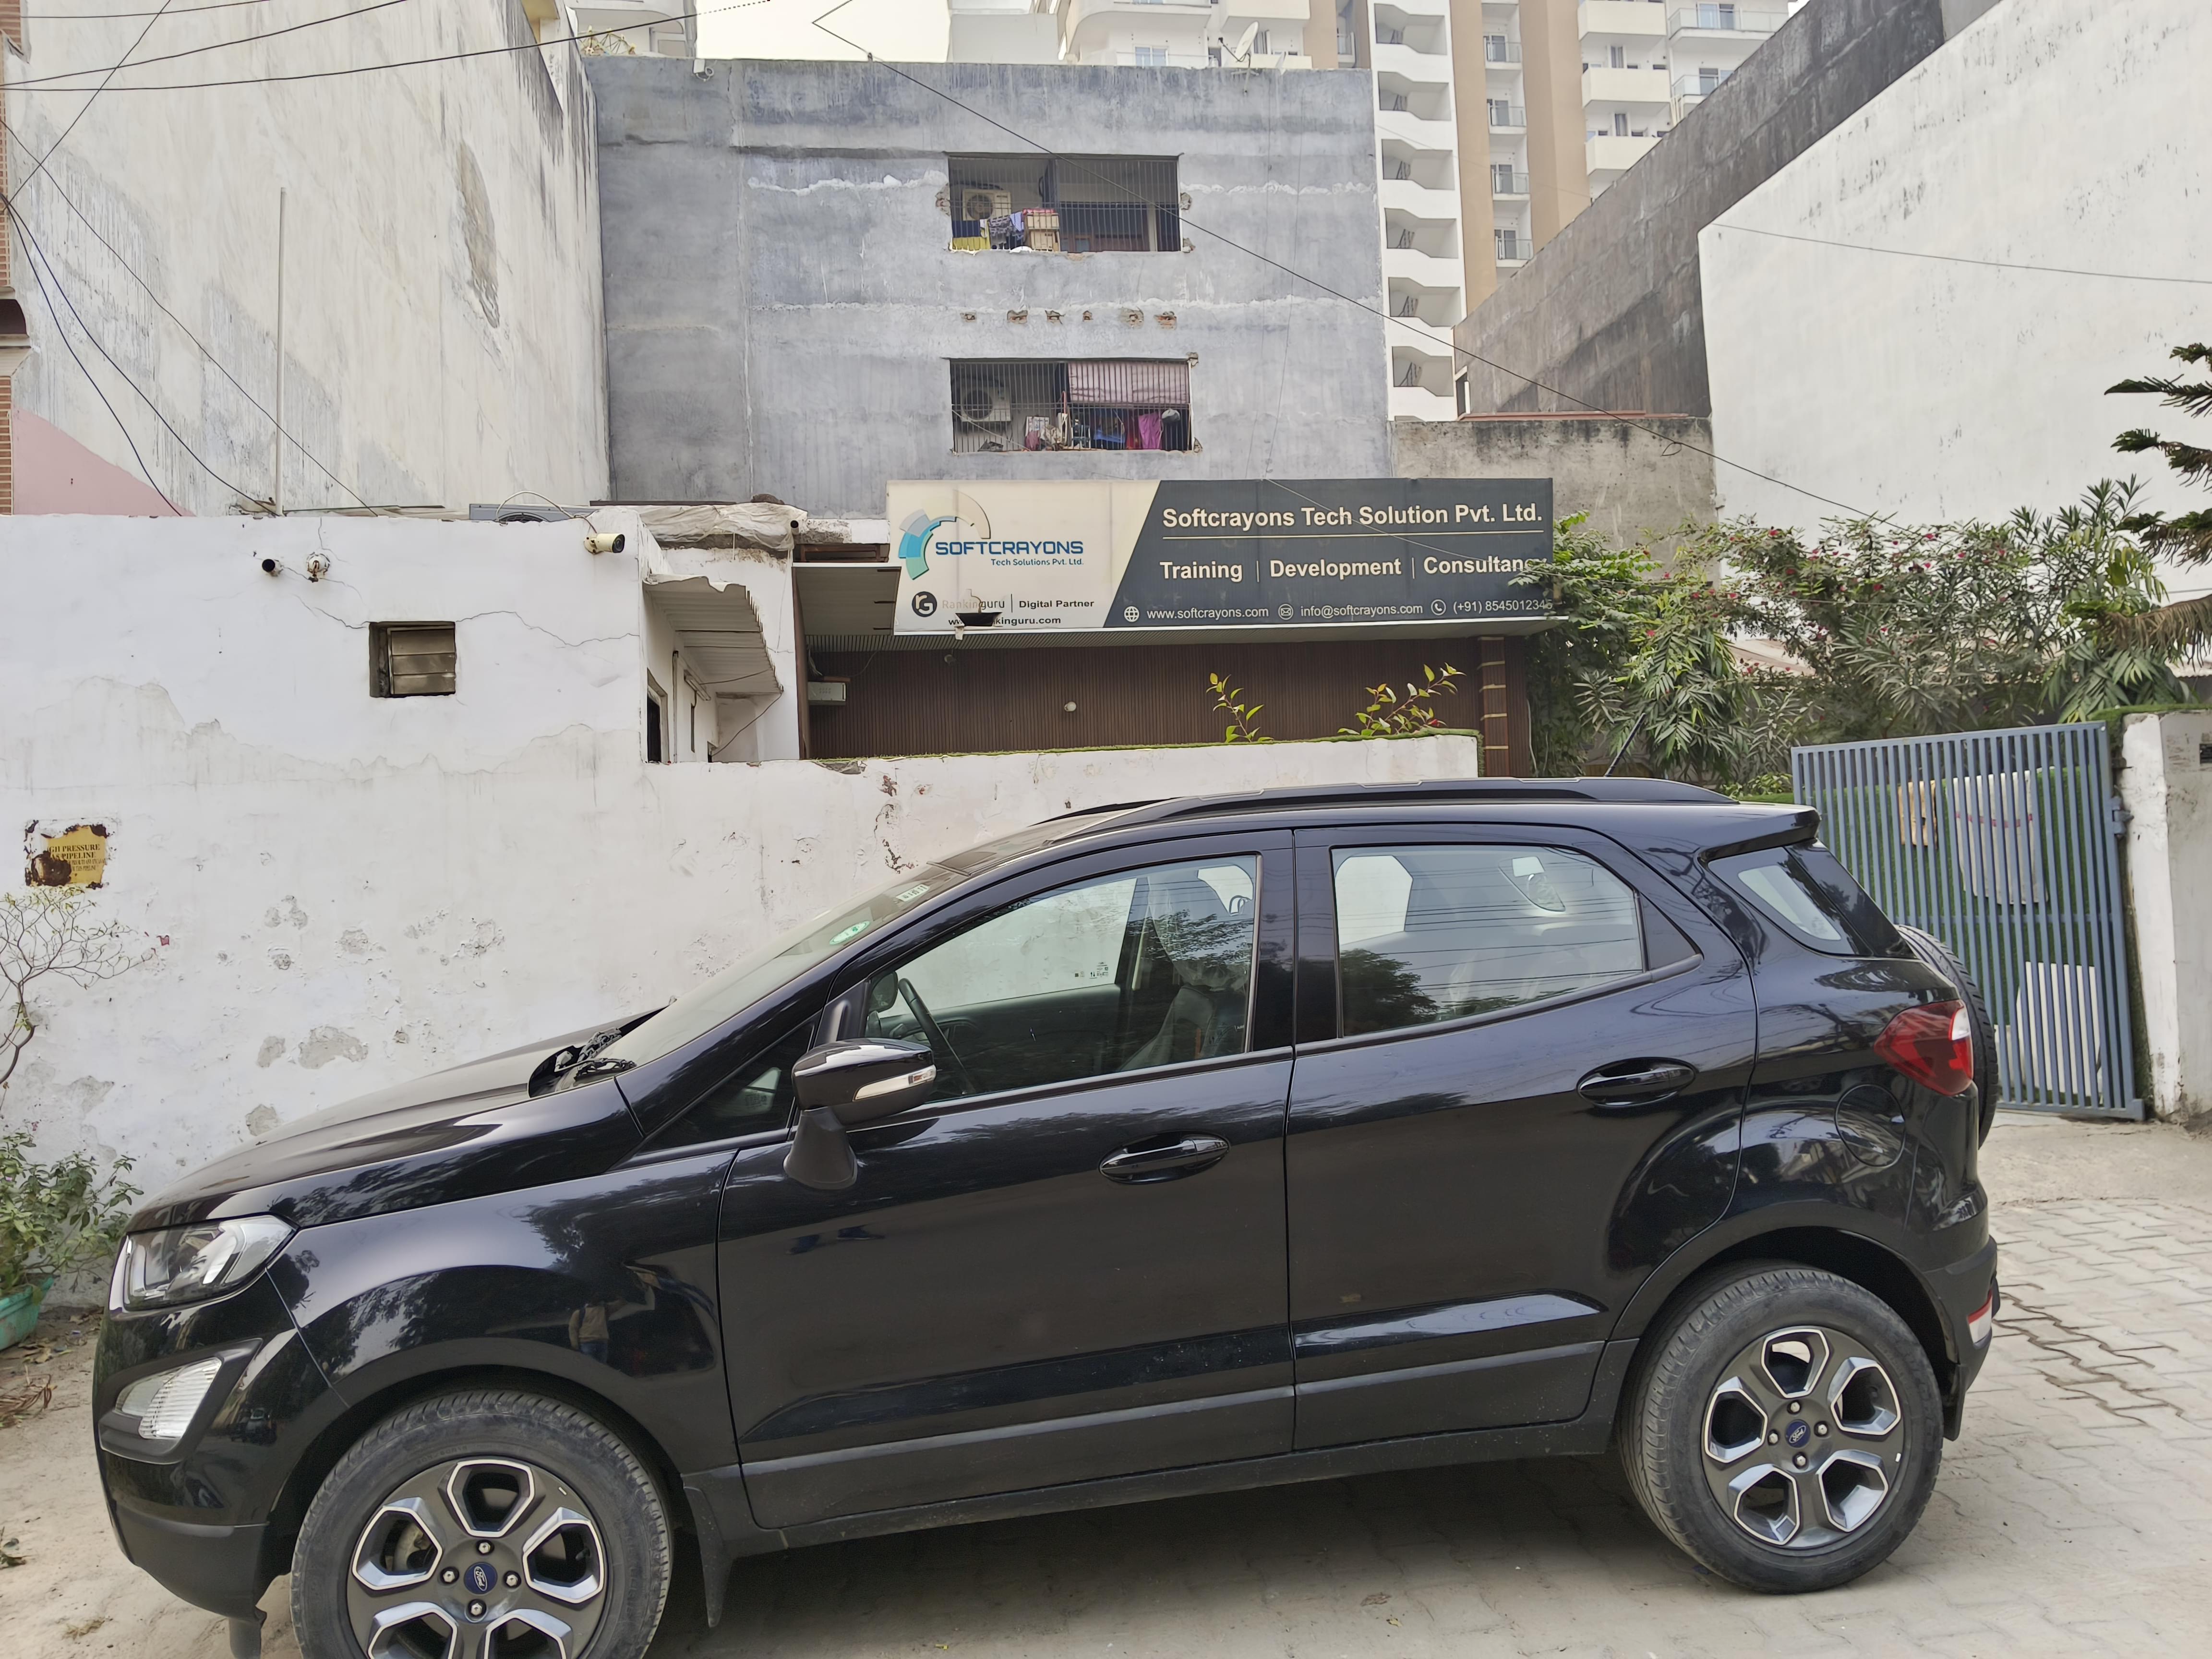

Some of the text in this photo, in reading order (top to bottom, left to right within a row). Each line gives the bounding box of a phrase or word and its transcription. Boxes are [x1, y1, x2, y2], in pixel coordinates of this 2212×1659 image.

[1163, 503, 1542, 531] Softcrayons Tech Solution Pvt. Ltd.
[936, 541, 1083, 555] SOFTCRAYONS
[1159, 555, 1547, 583] Training Development Consultanc
[1019, 600, 1052, 610] Digital
[1056, 600, 1094, 608] Partner
[1146, 608, 1269, 620] www.softcrayons.com
[1300, 604, 1423, 618] info@softcrayons.com
[1453, 601, 1482, 614] (+91)
[62, 844, 100, 853] PRESSURE
[475, 1567, 486, 1589] Ford
